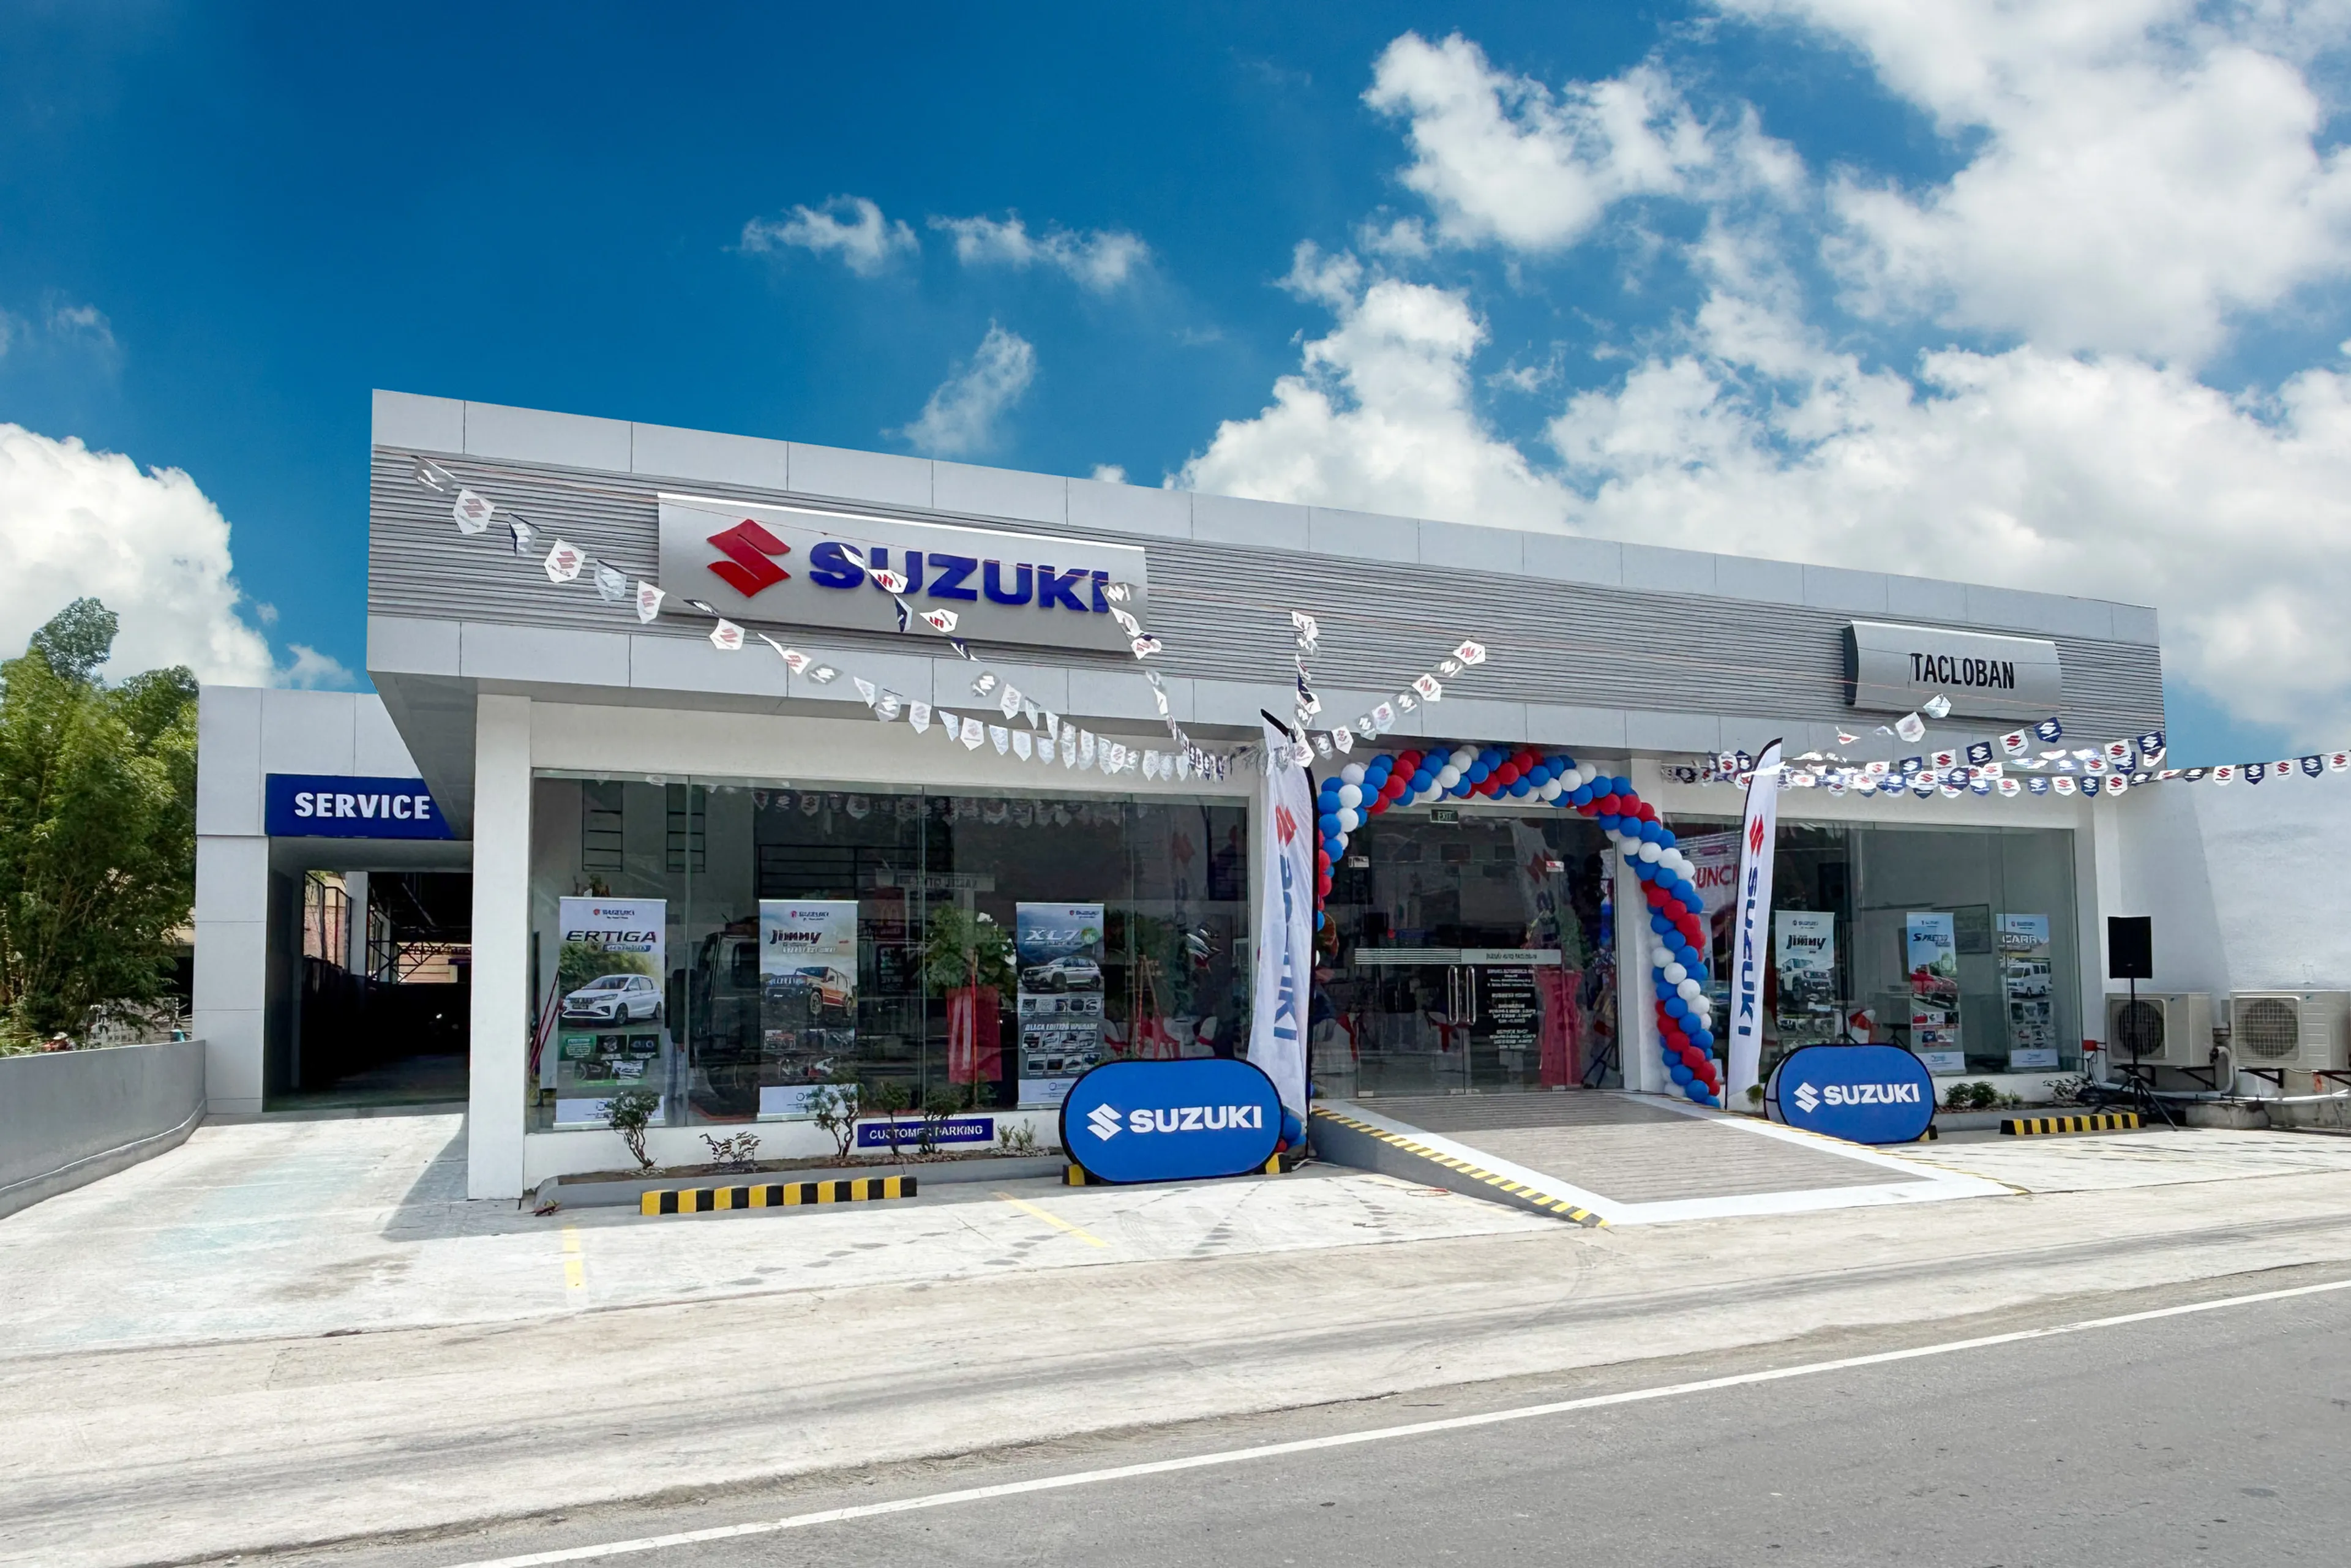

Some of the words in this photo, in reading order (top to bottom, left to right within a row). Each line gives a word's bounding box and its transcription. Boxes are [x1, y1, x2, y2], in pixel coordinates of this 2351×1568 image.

[809, 542, 1109, 613] SUZUKI
[1910, 653, 2015, 689] TACLOBAN
[294, 792, 430, 819] SERVICE
[1692, 863, 1739, 888] UNC
[566, 930, 657, 943] ERTIGA
[1738, 866, 1758, 1037] SUZUKI
[1823, 1083, 1921, 1105] SUZUKI
[1129, 1106, 1262, 1133] SUZUKI
[869, 1127, 932, 1140] CUSTOME
